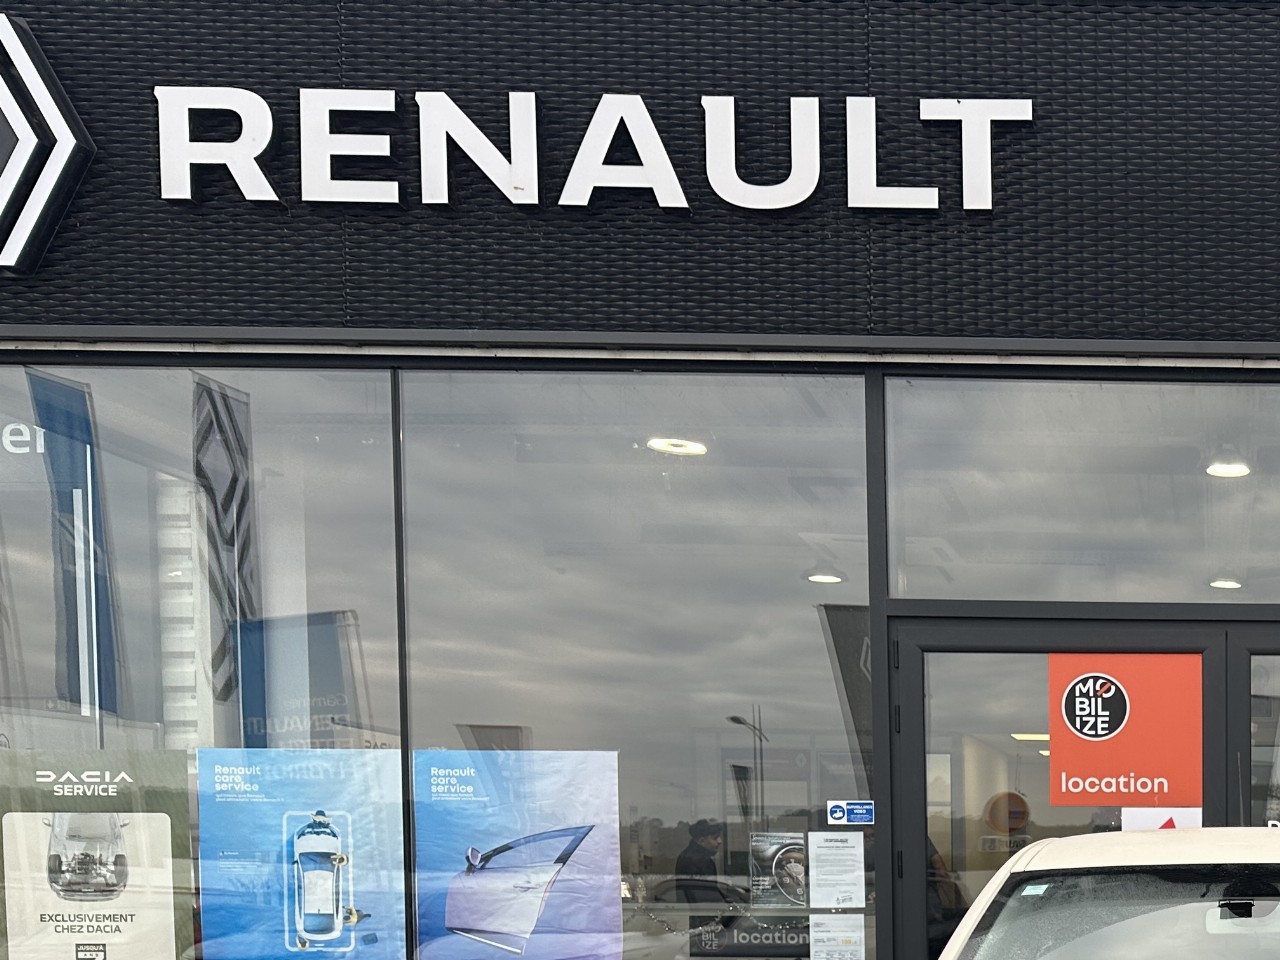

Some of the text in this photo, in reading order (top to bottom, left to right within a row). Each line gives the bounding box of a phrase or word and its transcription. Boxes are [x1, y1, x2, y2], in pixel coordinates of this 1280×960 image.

[153, 85, 1034, 210] RENAULT
[214, 764, 261, 775] Renault
[430, 767, 476, 777] Renault
[35, 770, 134, 783] DACIA
[214, 775, 242, 783] care
[430, 776, 458, 785] care
[215, 782, 260, 791] service
[1061, 771, 1169, 793] location
[53, 784, 118, 796] SERVICE
[430, 784, 474, 793] service
[39, 913, 136, 923] EXCLUSIVEMENT
[54, 924, 122, 934] CHEZ DACIA
[733, 929, 810, 945] location
